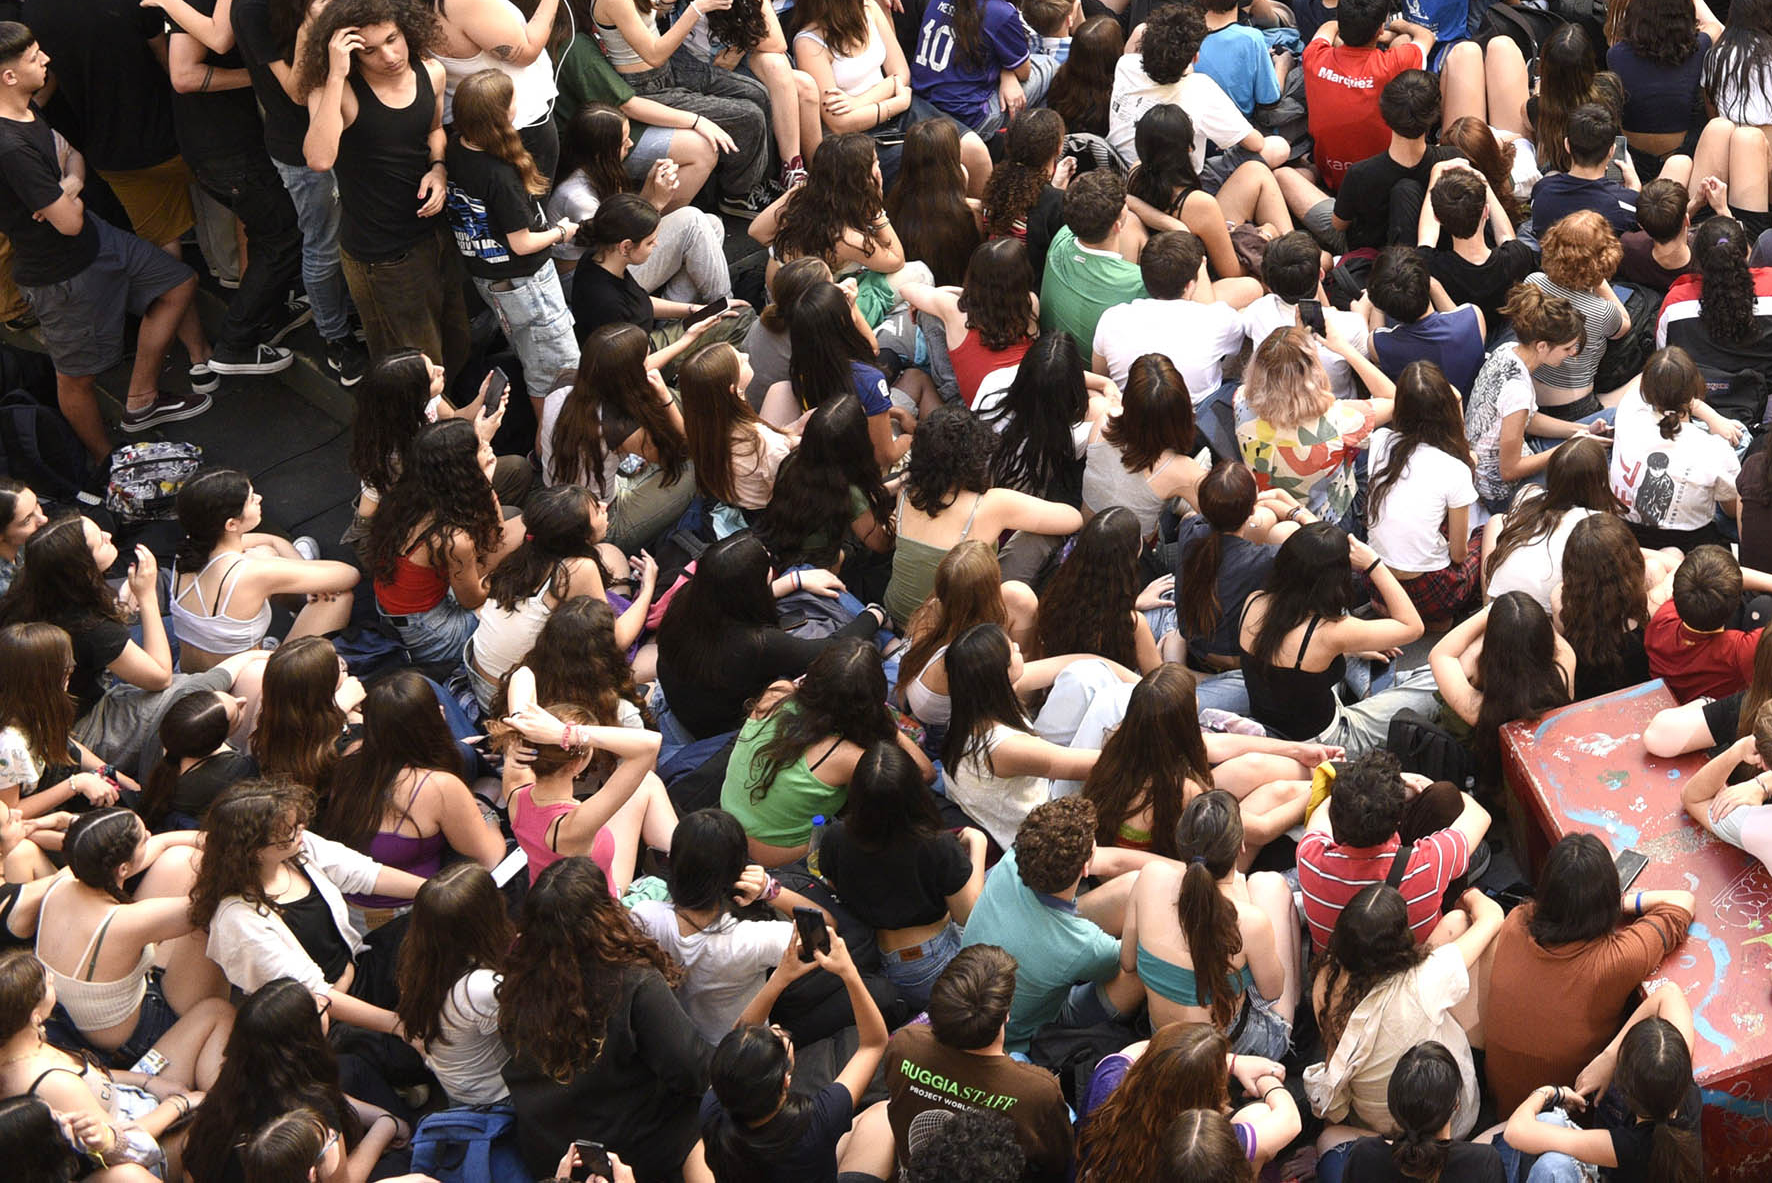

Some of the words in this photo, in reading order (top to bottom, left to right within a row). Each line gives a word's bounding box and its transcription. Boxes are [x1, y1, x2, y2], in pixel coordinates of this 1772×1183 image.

[915, 18, 957, 73] 10
[900, 1058, 959, 1097] RUGGIA
[959, 1086, 1018, 1112] STAFF
[909, 1084, 942, 1103] PROJECT
